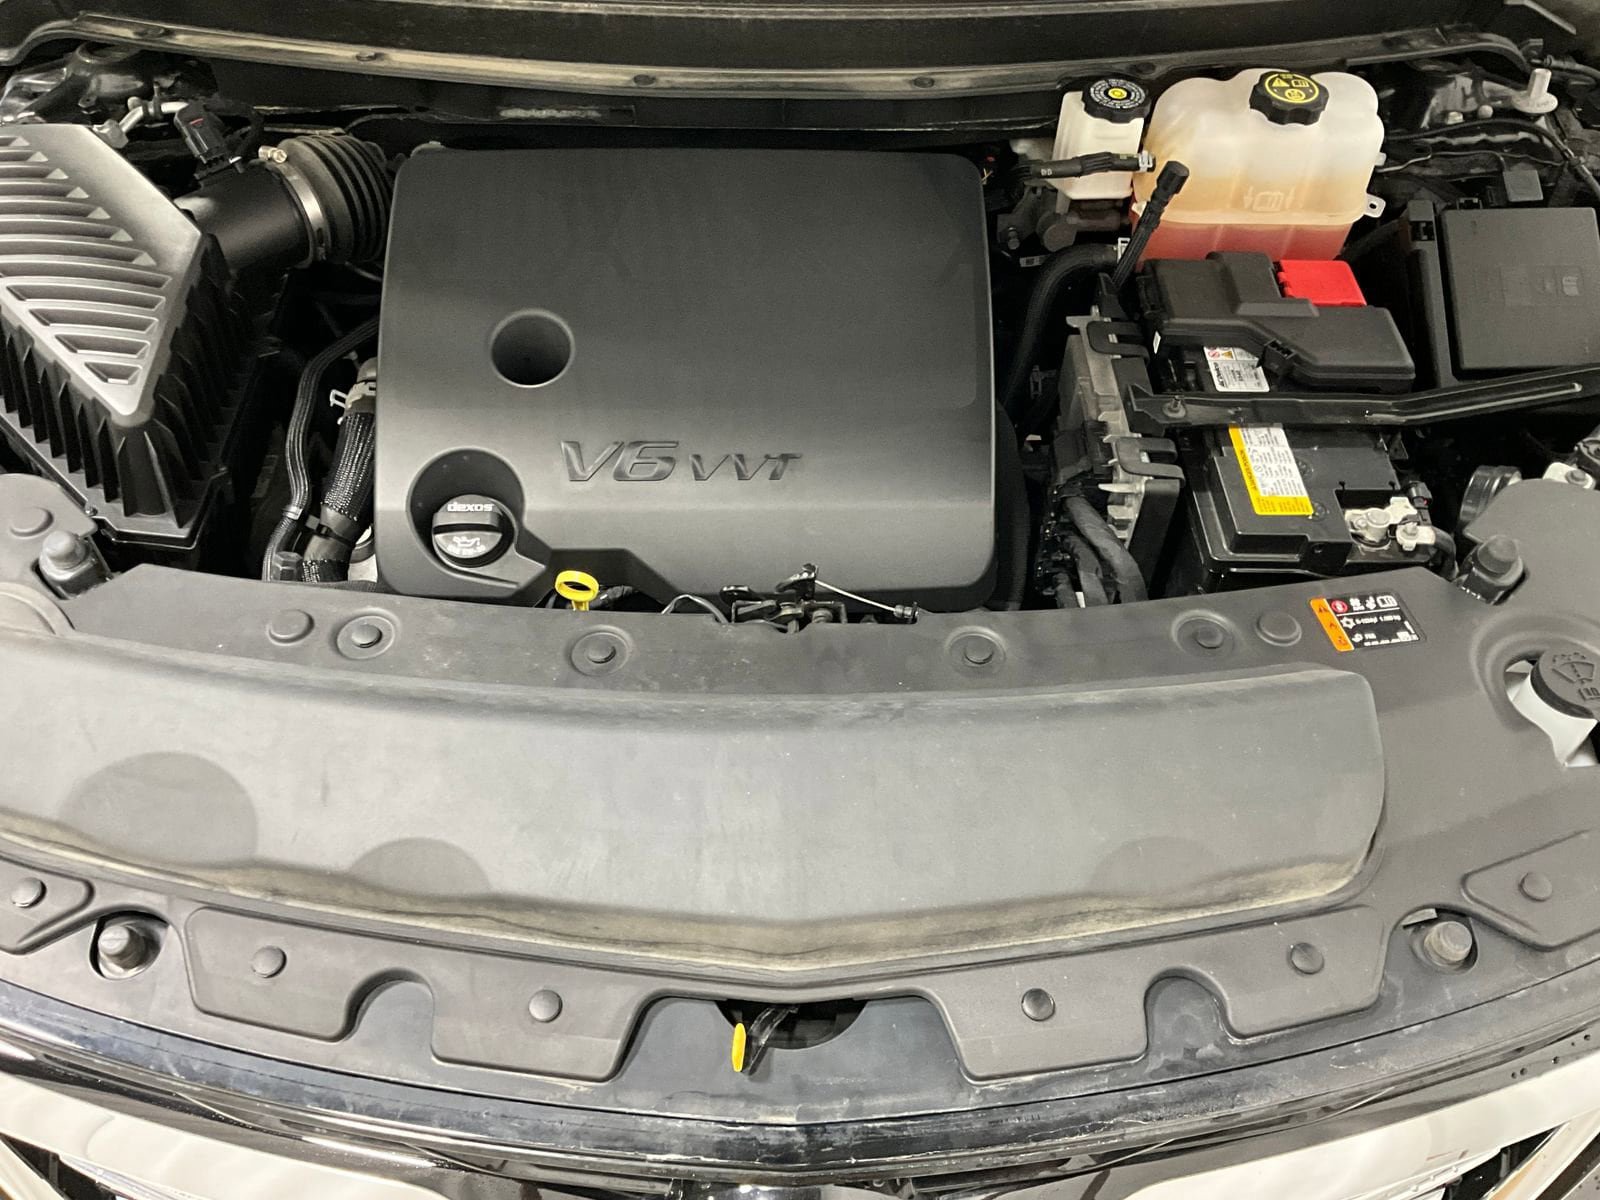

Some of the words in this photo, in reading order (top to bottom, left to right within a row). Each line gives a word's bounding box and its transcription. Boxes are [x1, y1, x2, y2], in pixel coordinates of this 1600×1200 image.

[560, 440, 679, 482] V6
[689, 453, 802, 481] VVT
[446, 501, 494, 512] dexos
